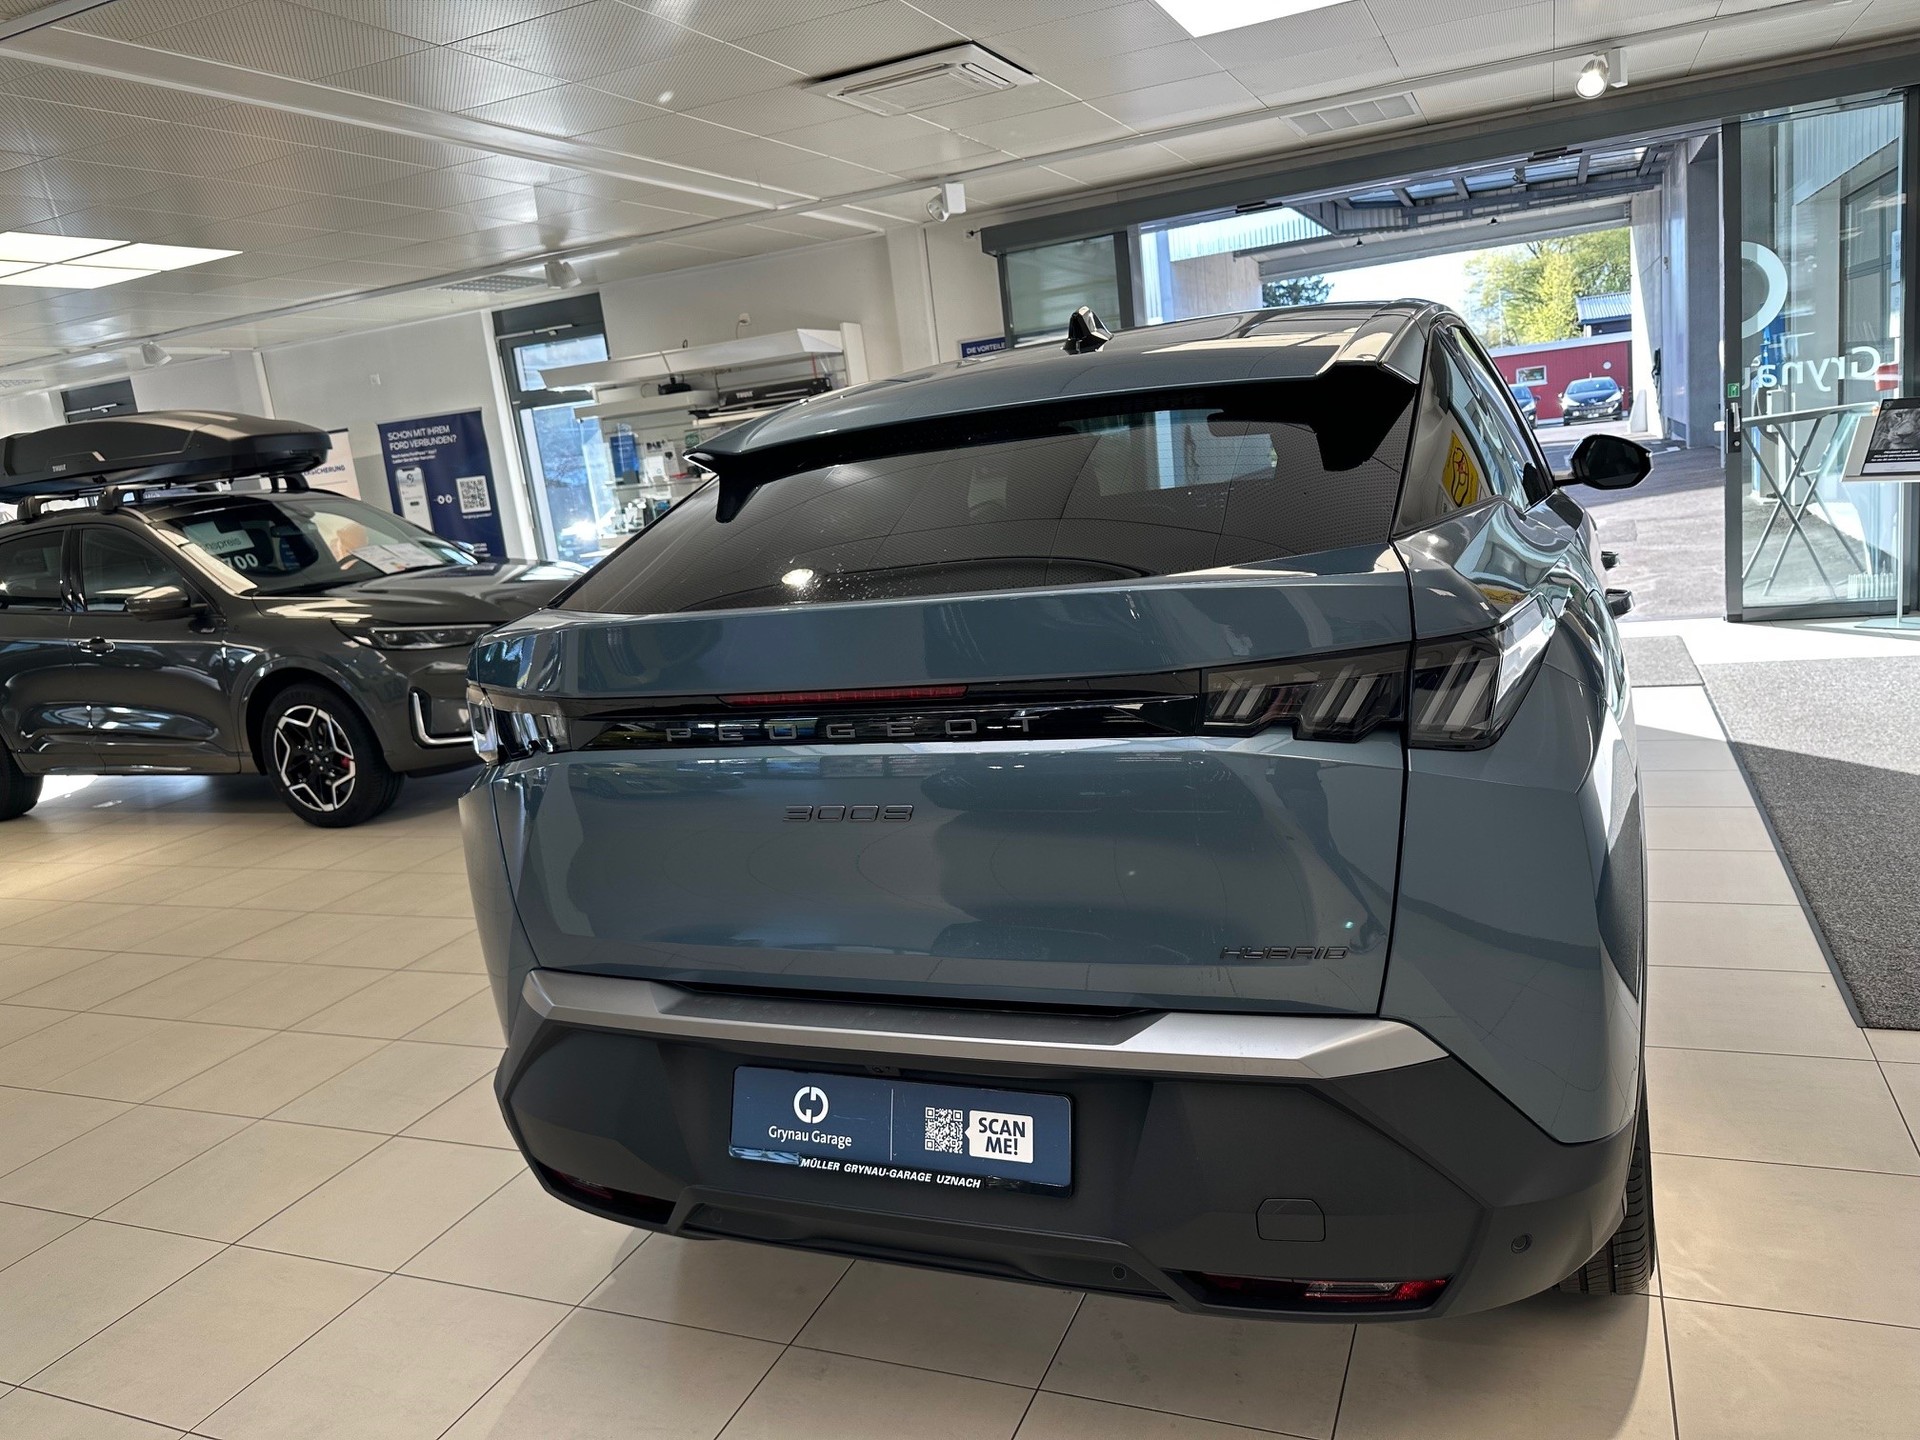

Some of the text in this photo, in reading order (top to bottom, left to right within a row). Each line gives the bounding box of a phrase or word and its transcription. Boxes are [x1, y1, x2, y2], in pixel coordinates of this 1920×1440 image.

[388, 425, 450, 441] SCHON MIT IHREM
[389, 434, 457, 451] FORD VERBUNDEN?
[665, 716, 1040, 742] PEUGEOT
[783, 804, 914, 823] 3008
[1220, 946, 1350, 960] HYBRID
[977, 1116, 1026, 1137] SCAN
[768, 1125, 852, 1149] Grynau Garage
[985, 1136, 1018, 1156] ME!
[800, 1156, 981, 1189] MÜLLER GRYNAU-GARAGE UZNACH
